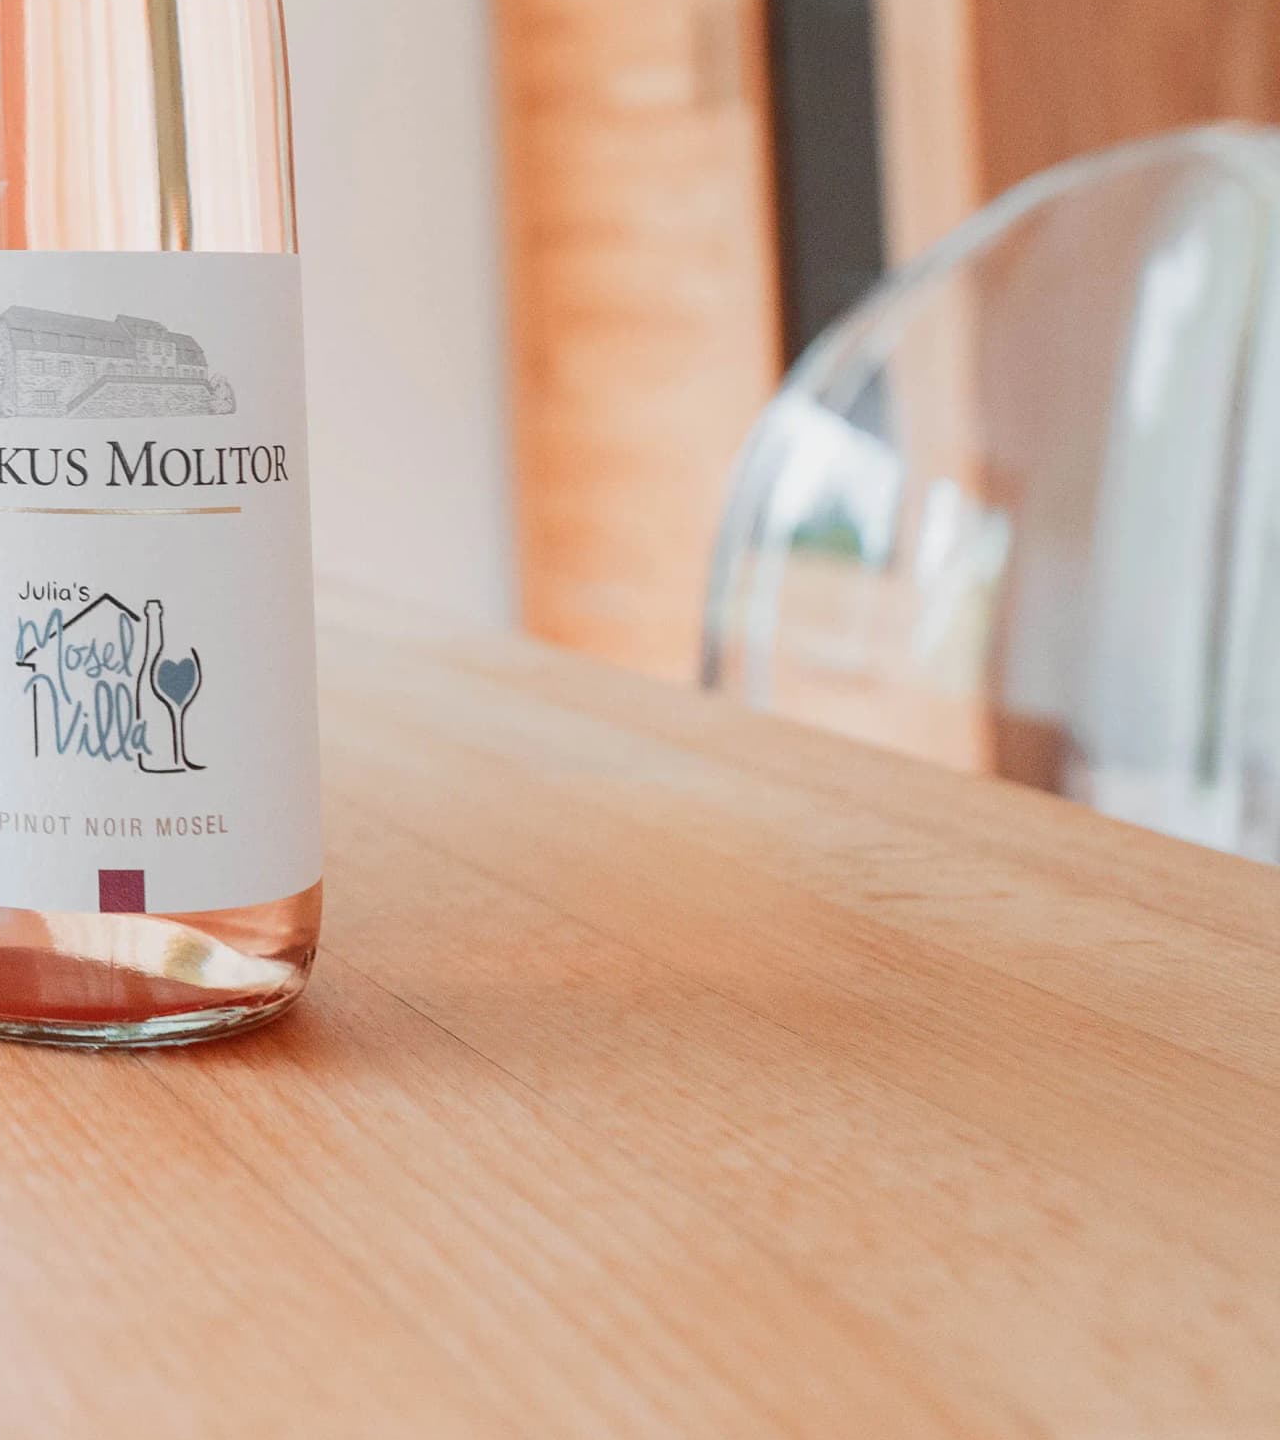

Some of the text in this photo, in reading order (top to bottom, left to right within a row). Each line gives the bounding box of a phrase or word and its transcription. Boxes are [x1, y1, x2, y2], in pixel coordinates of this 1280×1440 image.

[104, 440, 290, 488] MOLITOR
[18, 580, 91, 603] Julia's
[15, 607, 134, 705] Mosel
[23, 673, 153, 762] Villa
[84, 817, 143, 838] NOIR
[155, 814, 229, 837] MOSEL
